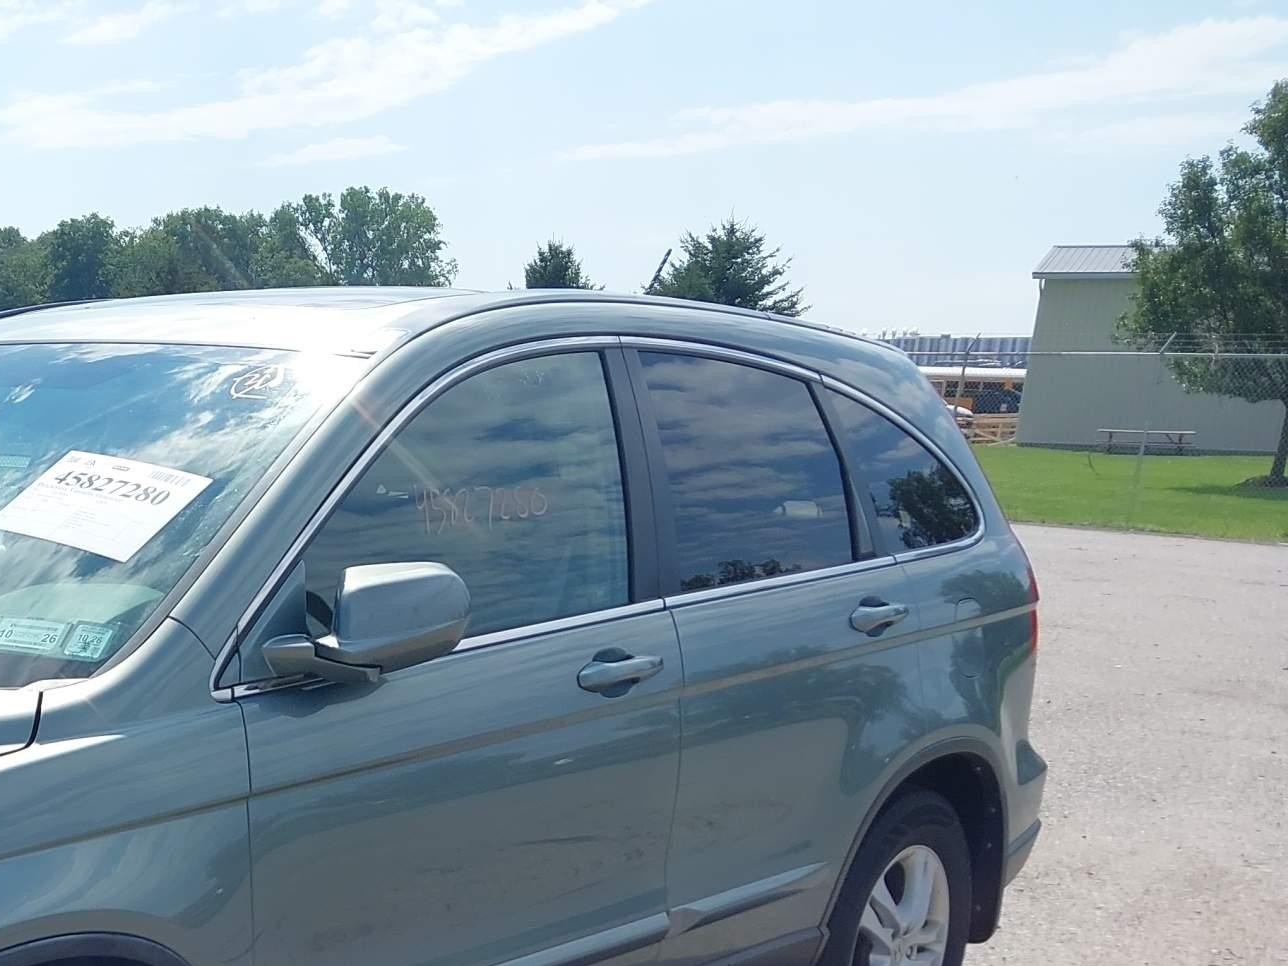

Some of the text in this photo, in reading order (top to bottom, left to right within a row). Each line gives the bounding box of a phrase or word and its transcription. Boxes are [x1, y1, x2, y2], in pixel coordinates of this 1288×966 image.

[54, 470, 171, 506] 45827280
[0, 629, 58, 644] 10 26
